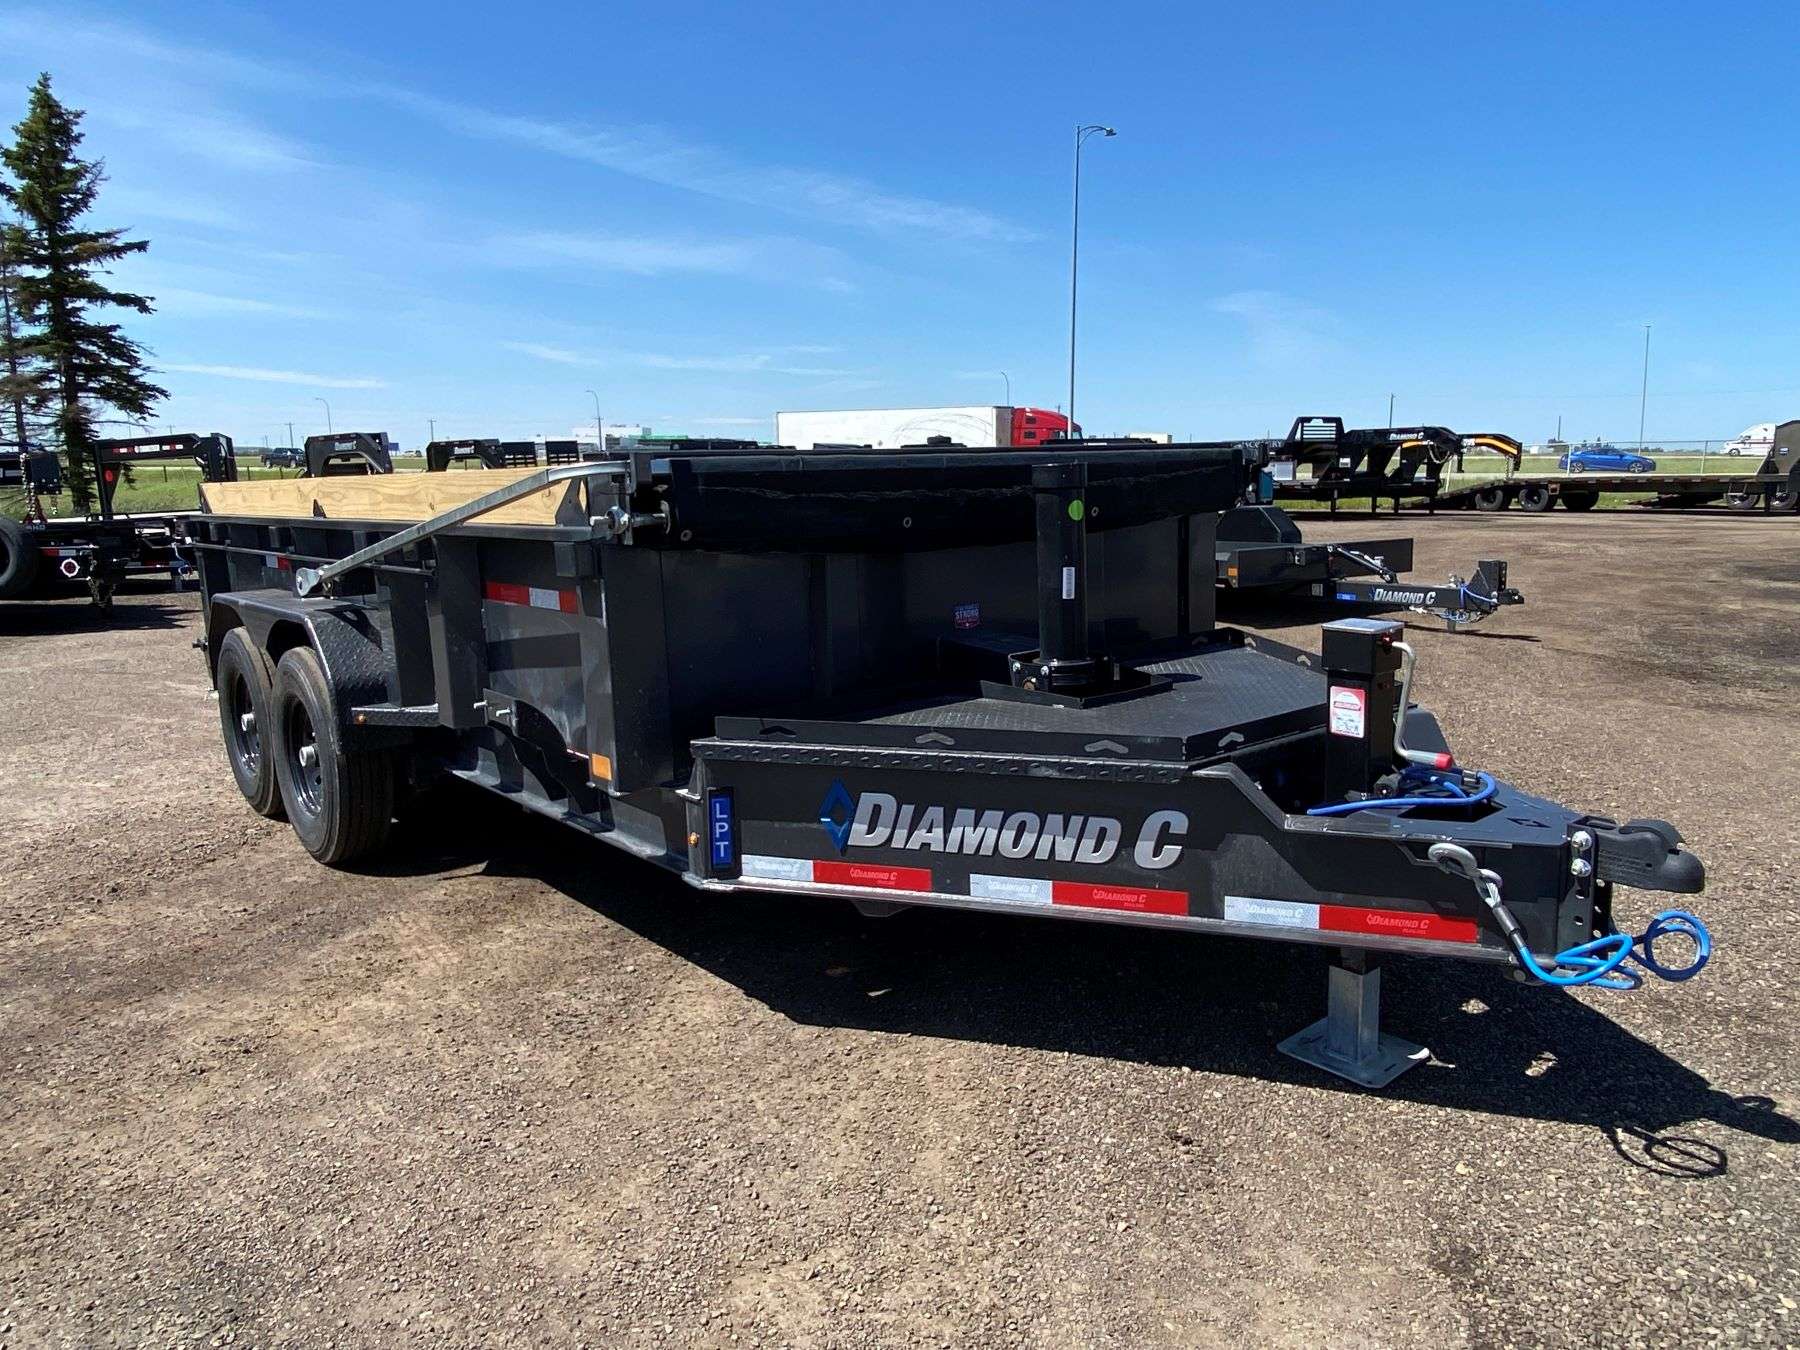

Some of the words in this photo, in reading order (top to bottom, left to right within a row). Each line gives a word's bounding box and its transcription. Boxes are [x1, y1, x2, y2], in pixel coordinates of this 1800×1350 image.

[1374, 588, 1424, 604] DIAMOND
[1426, 591, 1436, 605] C
[847, 792, 1122, 864] DIAMOND
[1133, 810, 1189, 870] C
[890, 871, 898, 880] C
[1138, 893, 1147, 903] C
[1420, 919, 1430, 929] C
